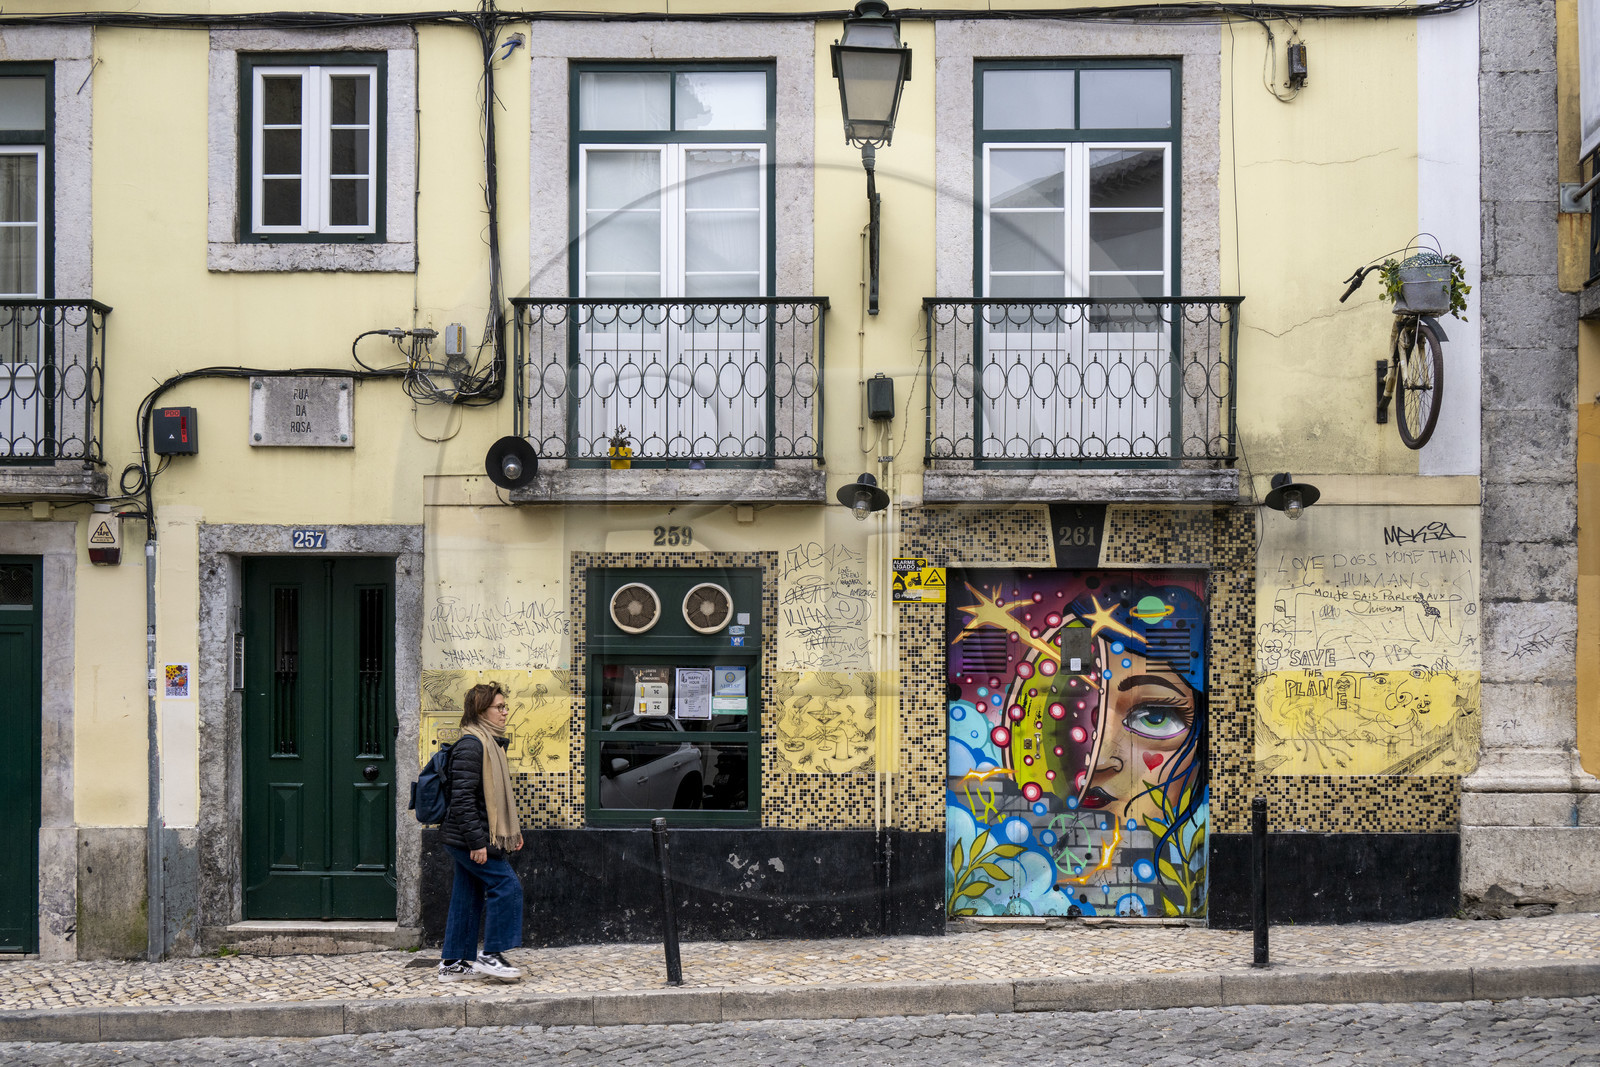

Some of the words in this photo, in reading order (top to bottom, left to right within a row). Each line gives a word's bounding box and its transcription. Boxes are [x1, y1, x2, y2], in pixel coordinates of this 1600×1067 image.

[293, 388, 309, 400] RUA
[295, 404, 307, 417] DA
[290, 421, 312, 433] ROSA
[294, 531, 325, 548] 257
[653, 525, 693, 546] 259
[1059, 526, 1096, 546] 261
[1278, 555, 1325, 572] LOVE
[1385, 550, 1424, 565] MORE
[1428, 548, 1472, 564] THAN
[1340, 571, 1430, 589] HUMANS
[1289, 648, 1336, 667] SAVE
[1302, 668, 1323, 677] THE
